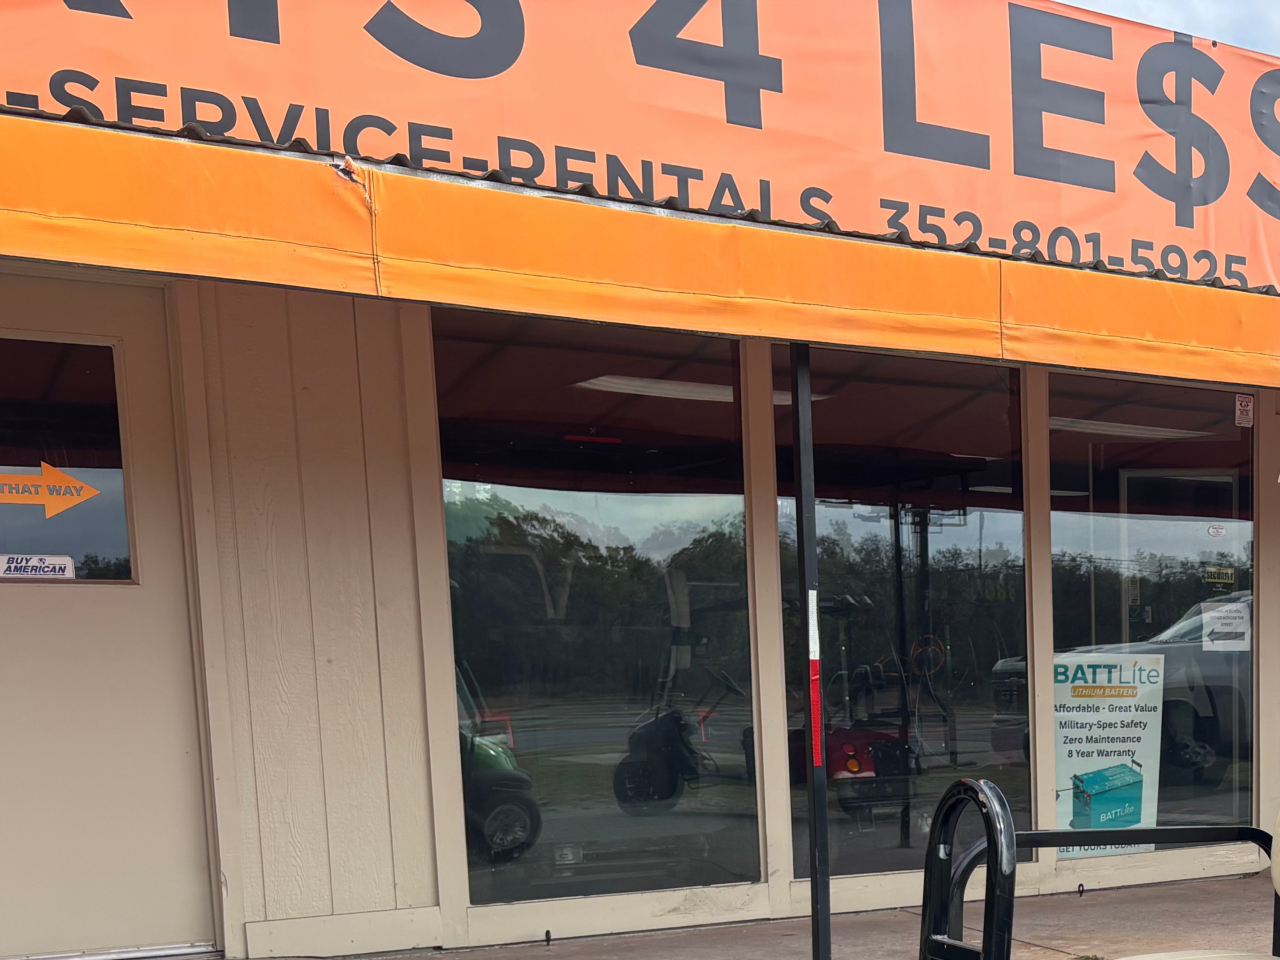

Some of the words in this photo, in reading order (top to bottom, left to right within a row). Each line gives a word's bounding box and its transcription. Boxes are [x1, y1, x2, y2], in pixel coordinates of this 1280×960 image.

[0, 483, 42, 496] THAT
[46, 485, 84, 497] WAY
[6, 557, 32, 565] BUY
[3, 565, 67, 574] AMERICAN
[1071, 688, 1104, 697] LITHIUM
[1105, 688, 1138, 697] BATTERY
[1054, 703, 1101, 713] Affordable
[1107, 703, 1132, 713] Great
[1134, 703, 1158, 713] Value
[1059, 720, 1118, 731] Military-Spec
[1120, 719, 1148, 731] Safety
[1063, 735, 1084, 745] Zero
[1085, 734, 1142, 744] Maintenance
[1067, 749, 1073, 758] 8
[1075, 749, 1095, 758] Year
[1096, 748, 1137, 759] Warranty
